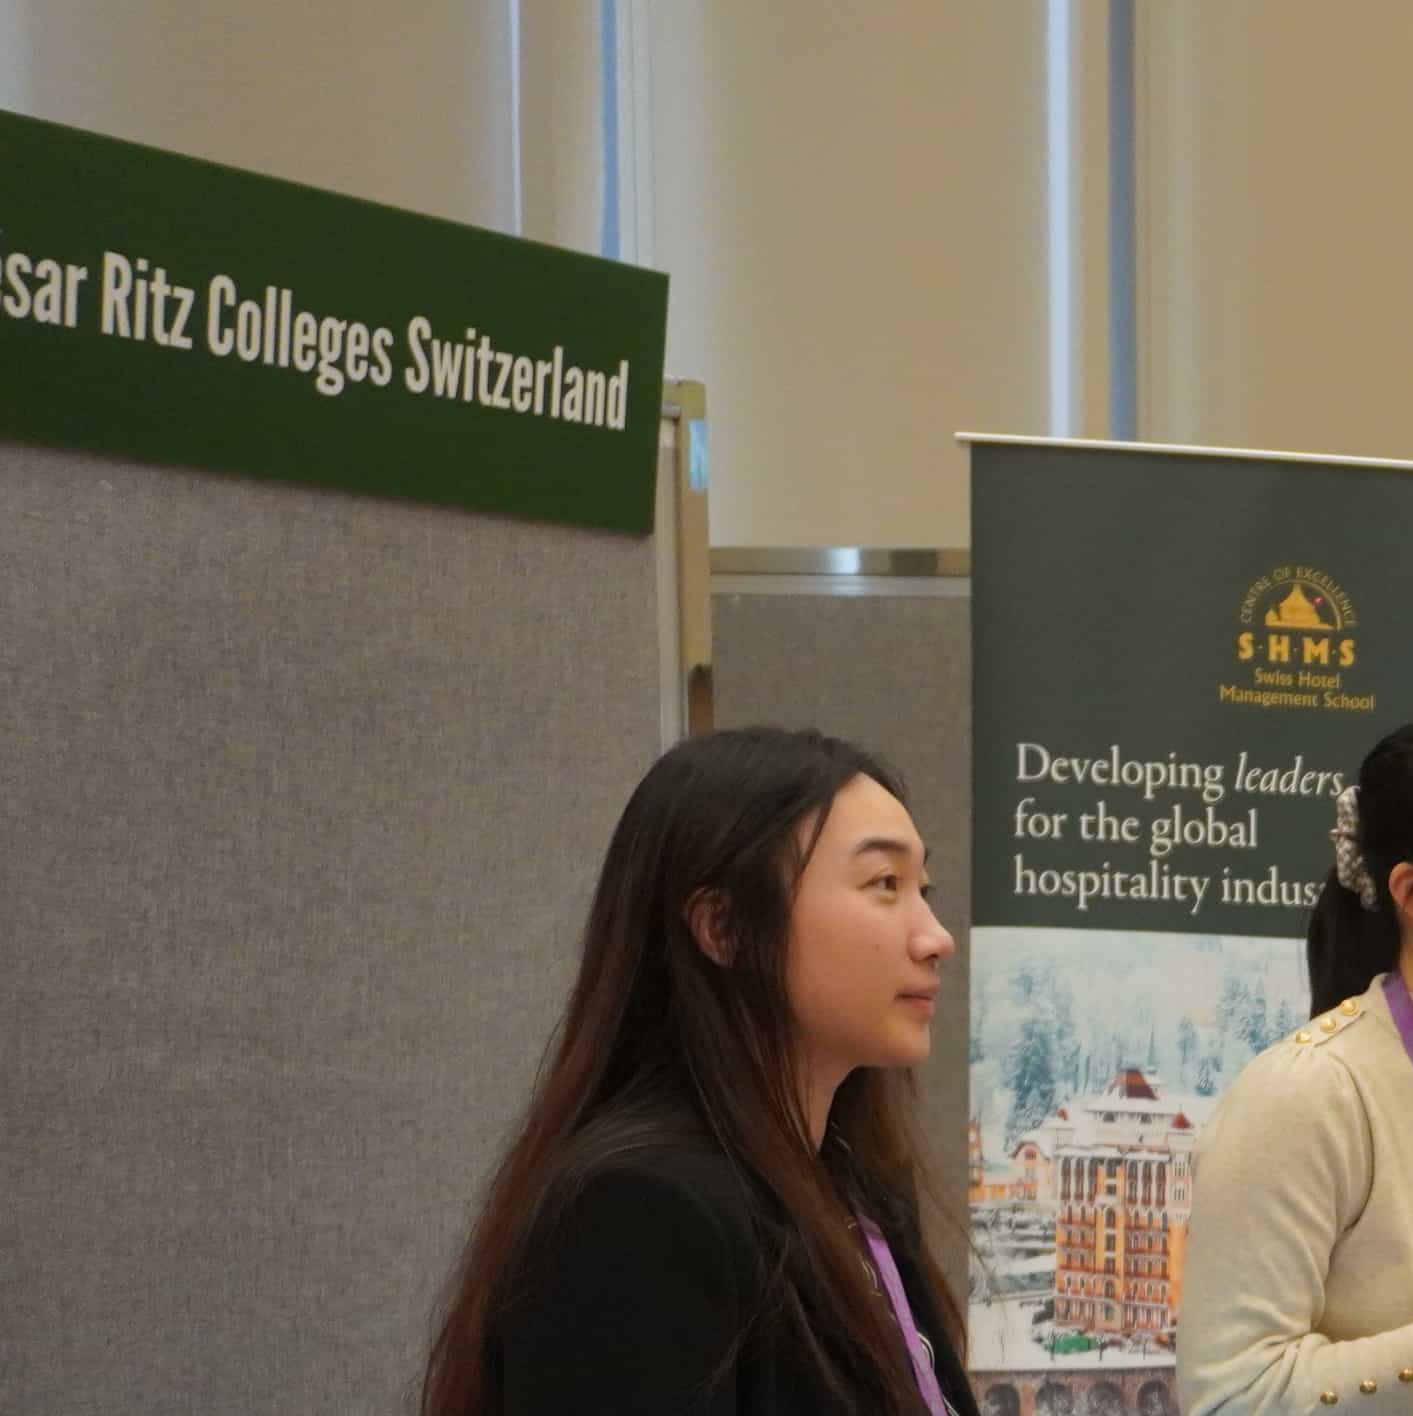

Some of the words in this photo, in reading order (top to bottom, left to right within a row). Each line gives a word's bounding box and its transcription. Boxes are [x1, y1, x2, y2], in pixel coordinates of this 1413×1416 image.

[0, 252, 88, 328] sar
[102, 250, 195, 350] Ritz
[208, 272, 394, 396] Colleges
[404, 316, 630, 431] Switzerland
[1219, 684, 1318, 707] Management
[1323, 690, 1375, 711] School
[1255, 667, 1292, 687] Swiss
[1298, 670, 1341, 689] Hotel
[1015, 743, 1225, 802] Developing
[1234, 752, 1343, 797] leaders
[1014, 797, 1067, 840] for
[1079, 802, 1140, 843] the
[1151, 806, 1259, 857] global
[1013, 853, 1211, 915] hospitality
[1221, 865, 1326, 906] indus
